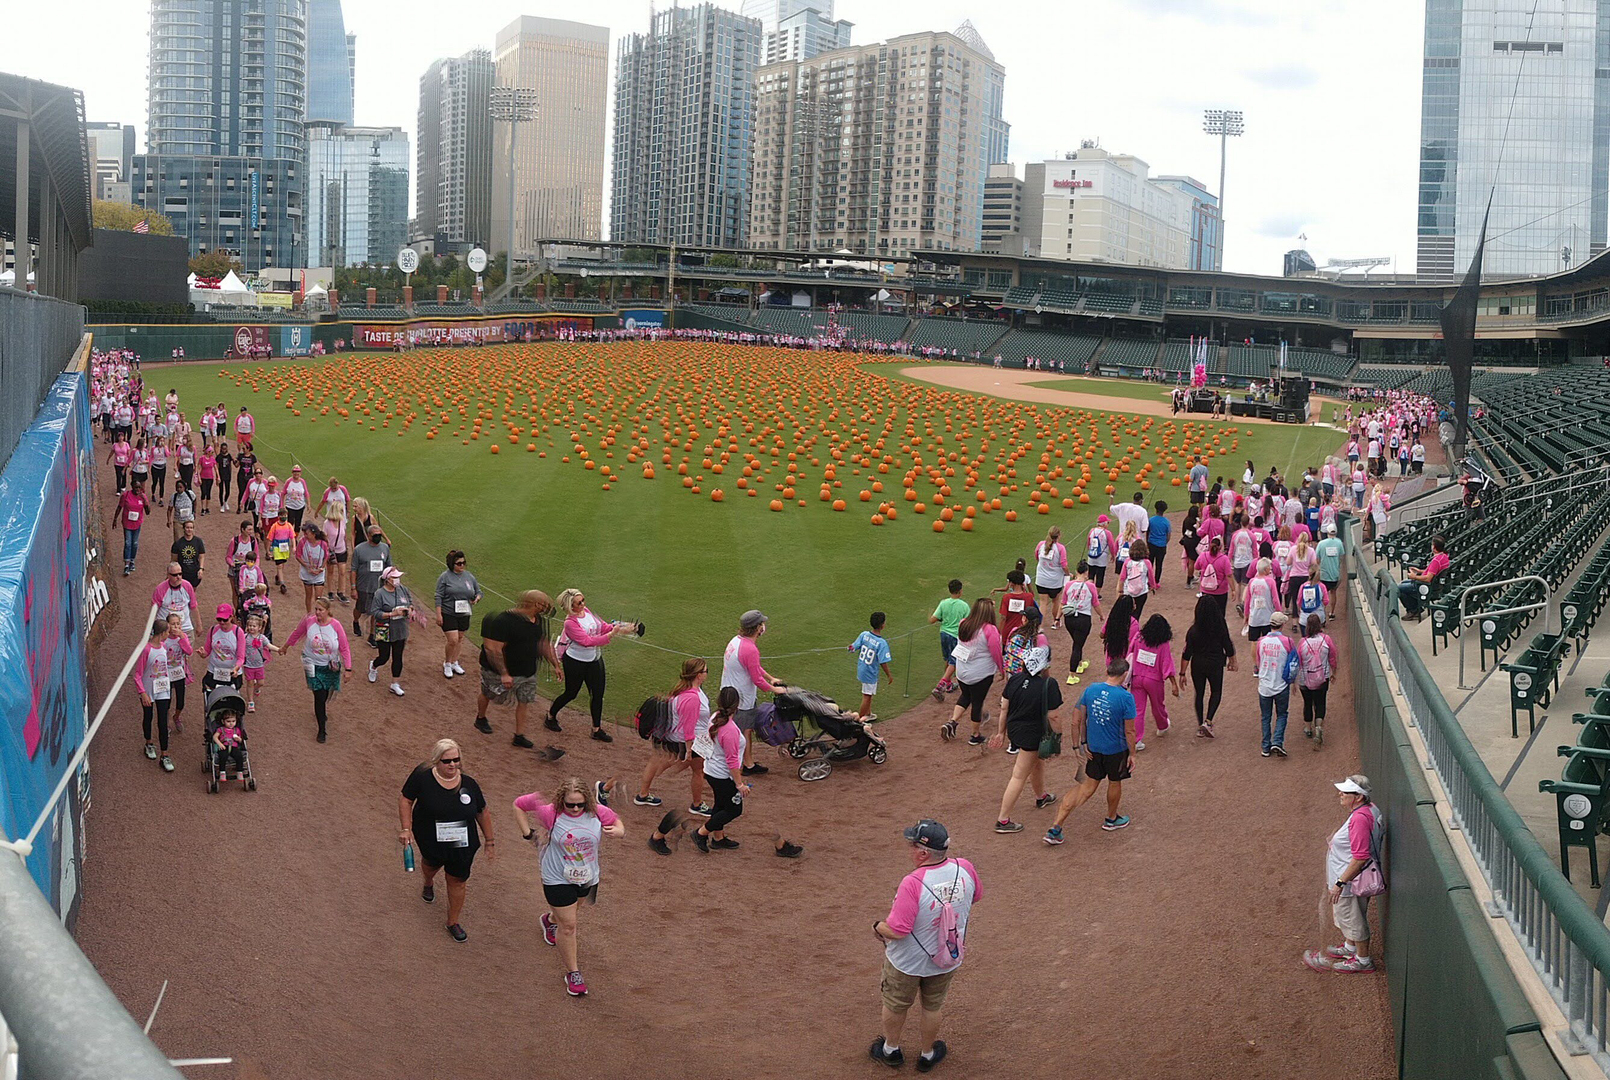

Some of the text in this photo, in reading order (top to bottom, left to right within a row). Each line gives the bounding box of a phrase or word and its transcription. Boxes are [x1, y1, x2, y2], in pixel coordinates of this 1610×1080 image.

[1053, 179, 1093, 188] Residence Inn
[364, 330, 392, 342] TASTE
[394, 332, 405, 341] OF
[407, 327, 447, 339] CHARLOTTE
[449, 325, 489, 338] PRESENTED
[491, 326, 501, 336] BY
[504, 321, 534, 336] FOOD
[859, 644, 875, 665] 89
[569, 869, 588, 878] 1642
